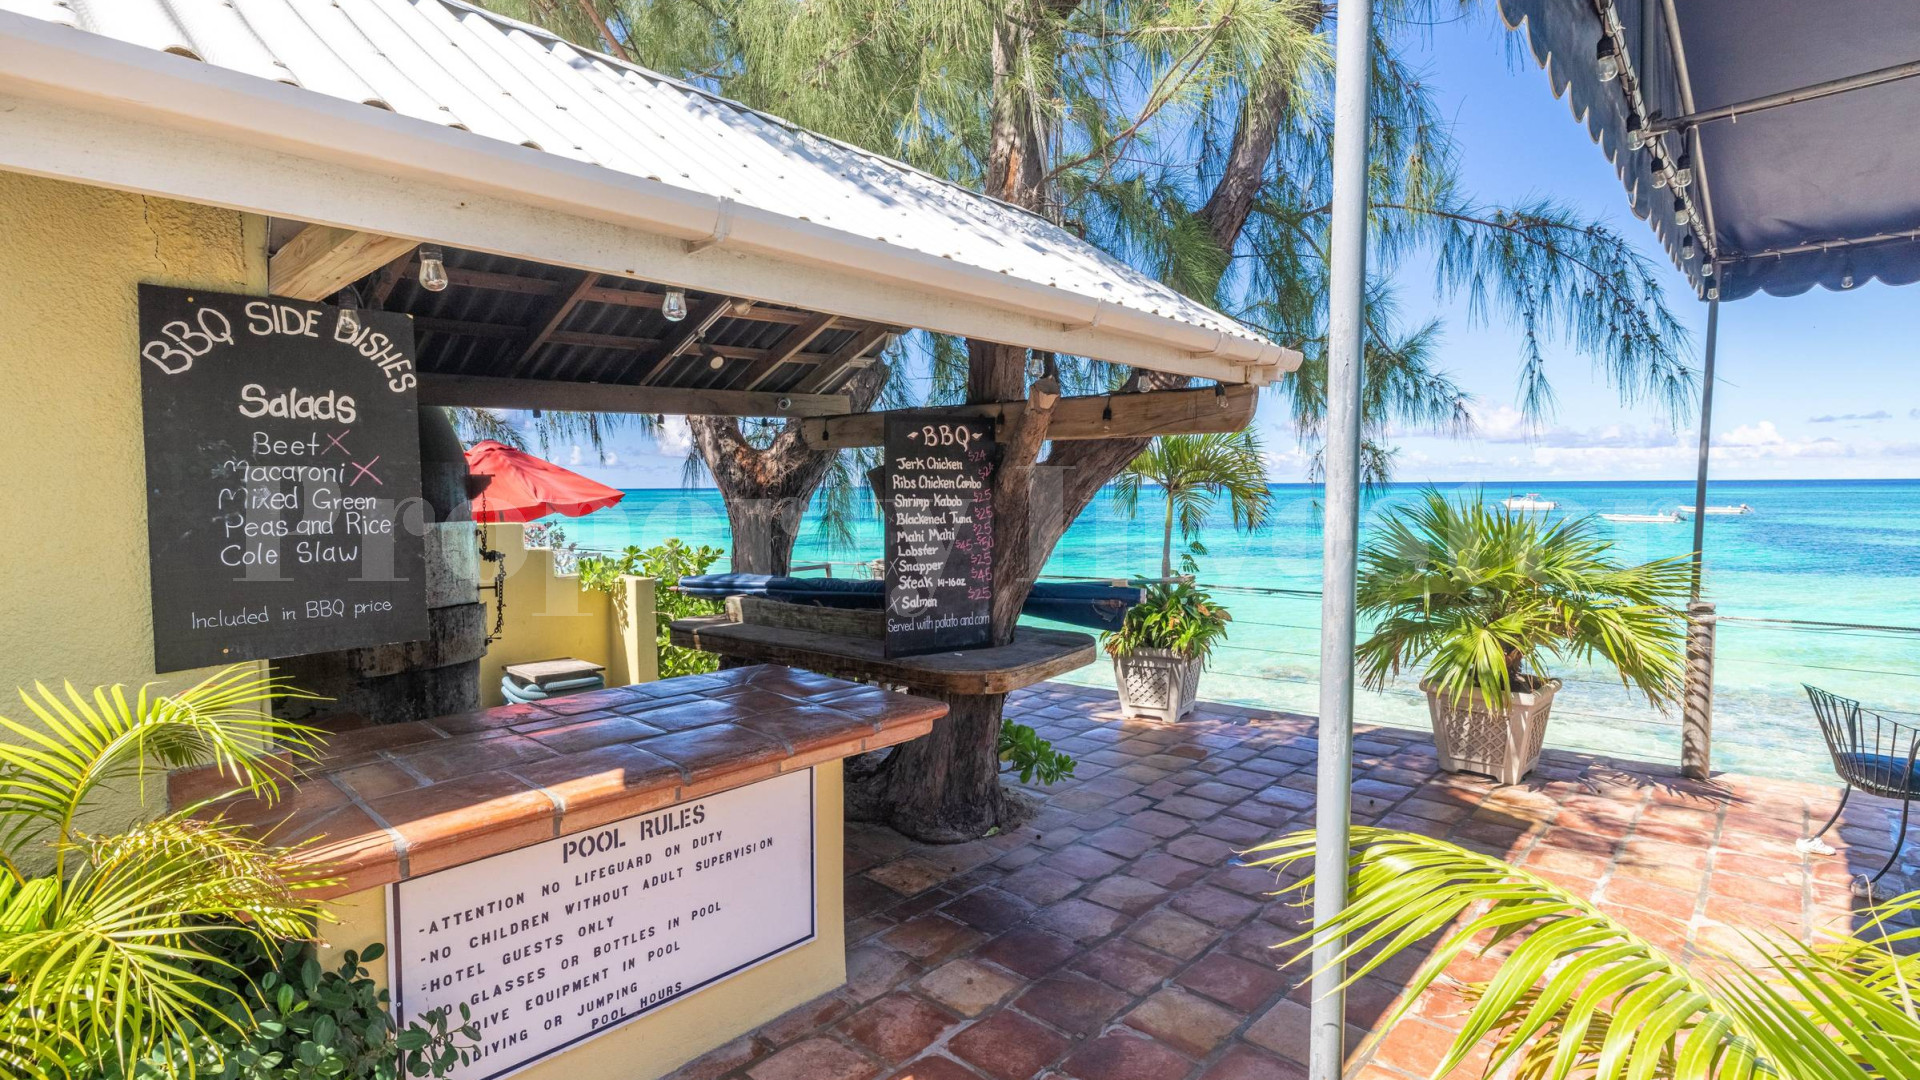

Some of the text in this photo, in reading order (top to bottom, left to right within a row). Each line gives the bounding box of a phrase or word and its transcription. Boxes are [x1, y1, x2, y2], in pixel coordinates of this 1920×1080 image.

[142, 302, 417, 392] BBQ SIDE DISHES
[239, 384, 356, 423] Salads
[252, 432, 320, 455] Beet
[922, 425, 969, 452] BBQ
[223, 460, 346, 483] Macaroni
[926, 456, 963, 470] Chicken
[892, 474, 916, 489] Ribs
[918, 474, 955, 489] Chicken
[956, 474, 982, 489] Combo
[218, 486, 377, 509] Mixed Green
[894, 493, 930, 511] Shrimp
[933, 492, 963, 507] Kabob
[225, 512, 392, 538] Peas and Rice
[896, 512, 946, 526] Blackened
[949, 511, 973, 524] Tuna
[896, 530, 924, 543] Mahi
[928, 528, 955, 541] Mahi
[220, 541, 358, 566] Cole Slaw
[897, 543, 938, 557] Lobster
[898, 559, 943, 575] Snapper
[897, 575, 933, 590] Steak
[191, 598, 393, 629] Included in BBQ price
[901, 594, 937, 609] Salmon
[887, 617, 914, 633] Served
[916, 615, 933, 630] with
[934, 612, 958, 633] potato
[960, 611, 974, 626] and
[563, 804, 705, 864] POOL RULES
[541, 881, 560, 897] NO
[575, 853, 652, 886] LIFEGUARD
[665, 844, 681, 858] ON
[692, 830, 724, 849] DUTY
[469, 911, 550, 949] CHILDREN
[565, 885, 629, 915] WITHOUT
[642, 867, 684, 890] ADULT
[695, 837, 774, 872] SUPERVISION
[502, 934, 564, 965] GUESTS
[578, 916, 615, 937] ONLY
[470, 967, 546, 1006] GLASSES
[561, 955, 580, 970] OR
[593, 926, 656, 958] BOTTLES
[667, 917, 680, 930] IN
[691, 902, 722, 921] POOL
[472, 1008, 510, 1034] DIVE
[525, 968, 610, 1011] EQUIPMENT
[622, 957, 636, 972] IN
[647, 941, 681, 962] POOL
[591, 982, 683, 1030] POOL HOURS
[472, 1029, 529, 1062] DIVING
[543, 1015, 563, 1031] OR
[577, 982, 638, 1017] JUMPING
